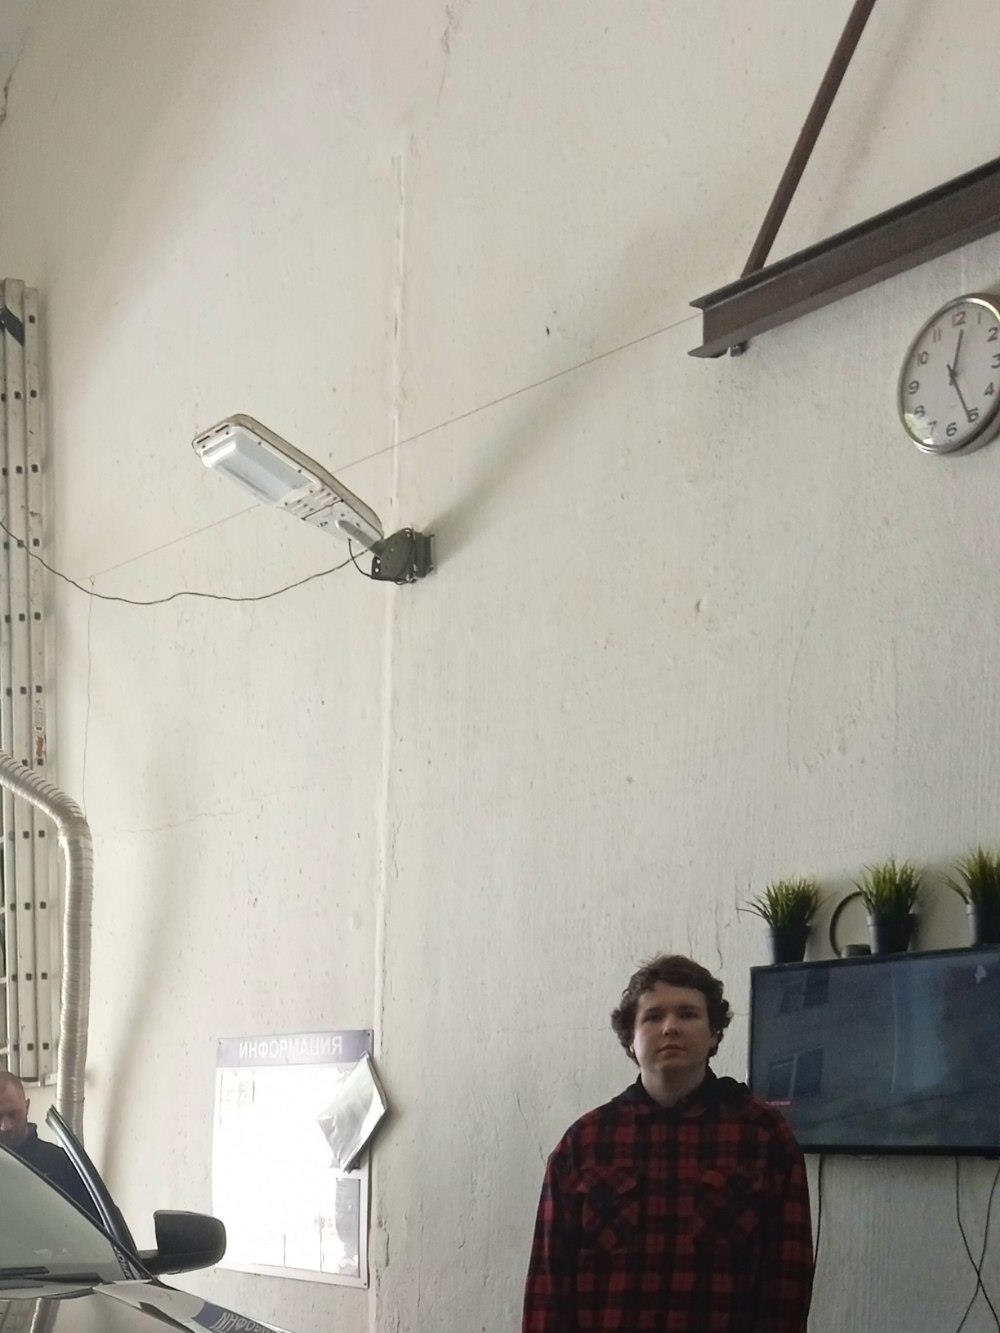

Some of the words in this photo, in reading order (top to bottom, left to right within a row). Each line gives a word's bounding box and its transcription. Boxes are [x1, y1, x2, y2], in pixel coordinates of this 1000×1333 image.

[933, 328, 941, 343] 11
[987, 327, 998, 342] 2
[917, 351, 929, 366] 10
[908, 380, 919, 395] 9
[983, 382, 994, 396] 4
[946, 422, 957, 437] 6
[239, 1035, 343, 1058] ИНФОРМАЦИЯ
